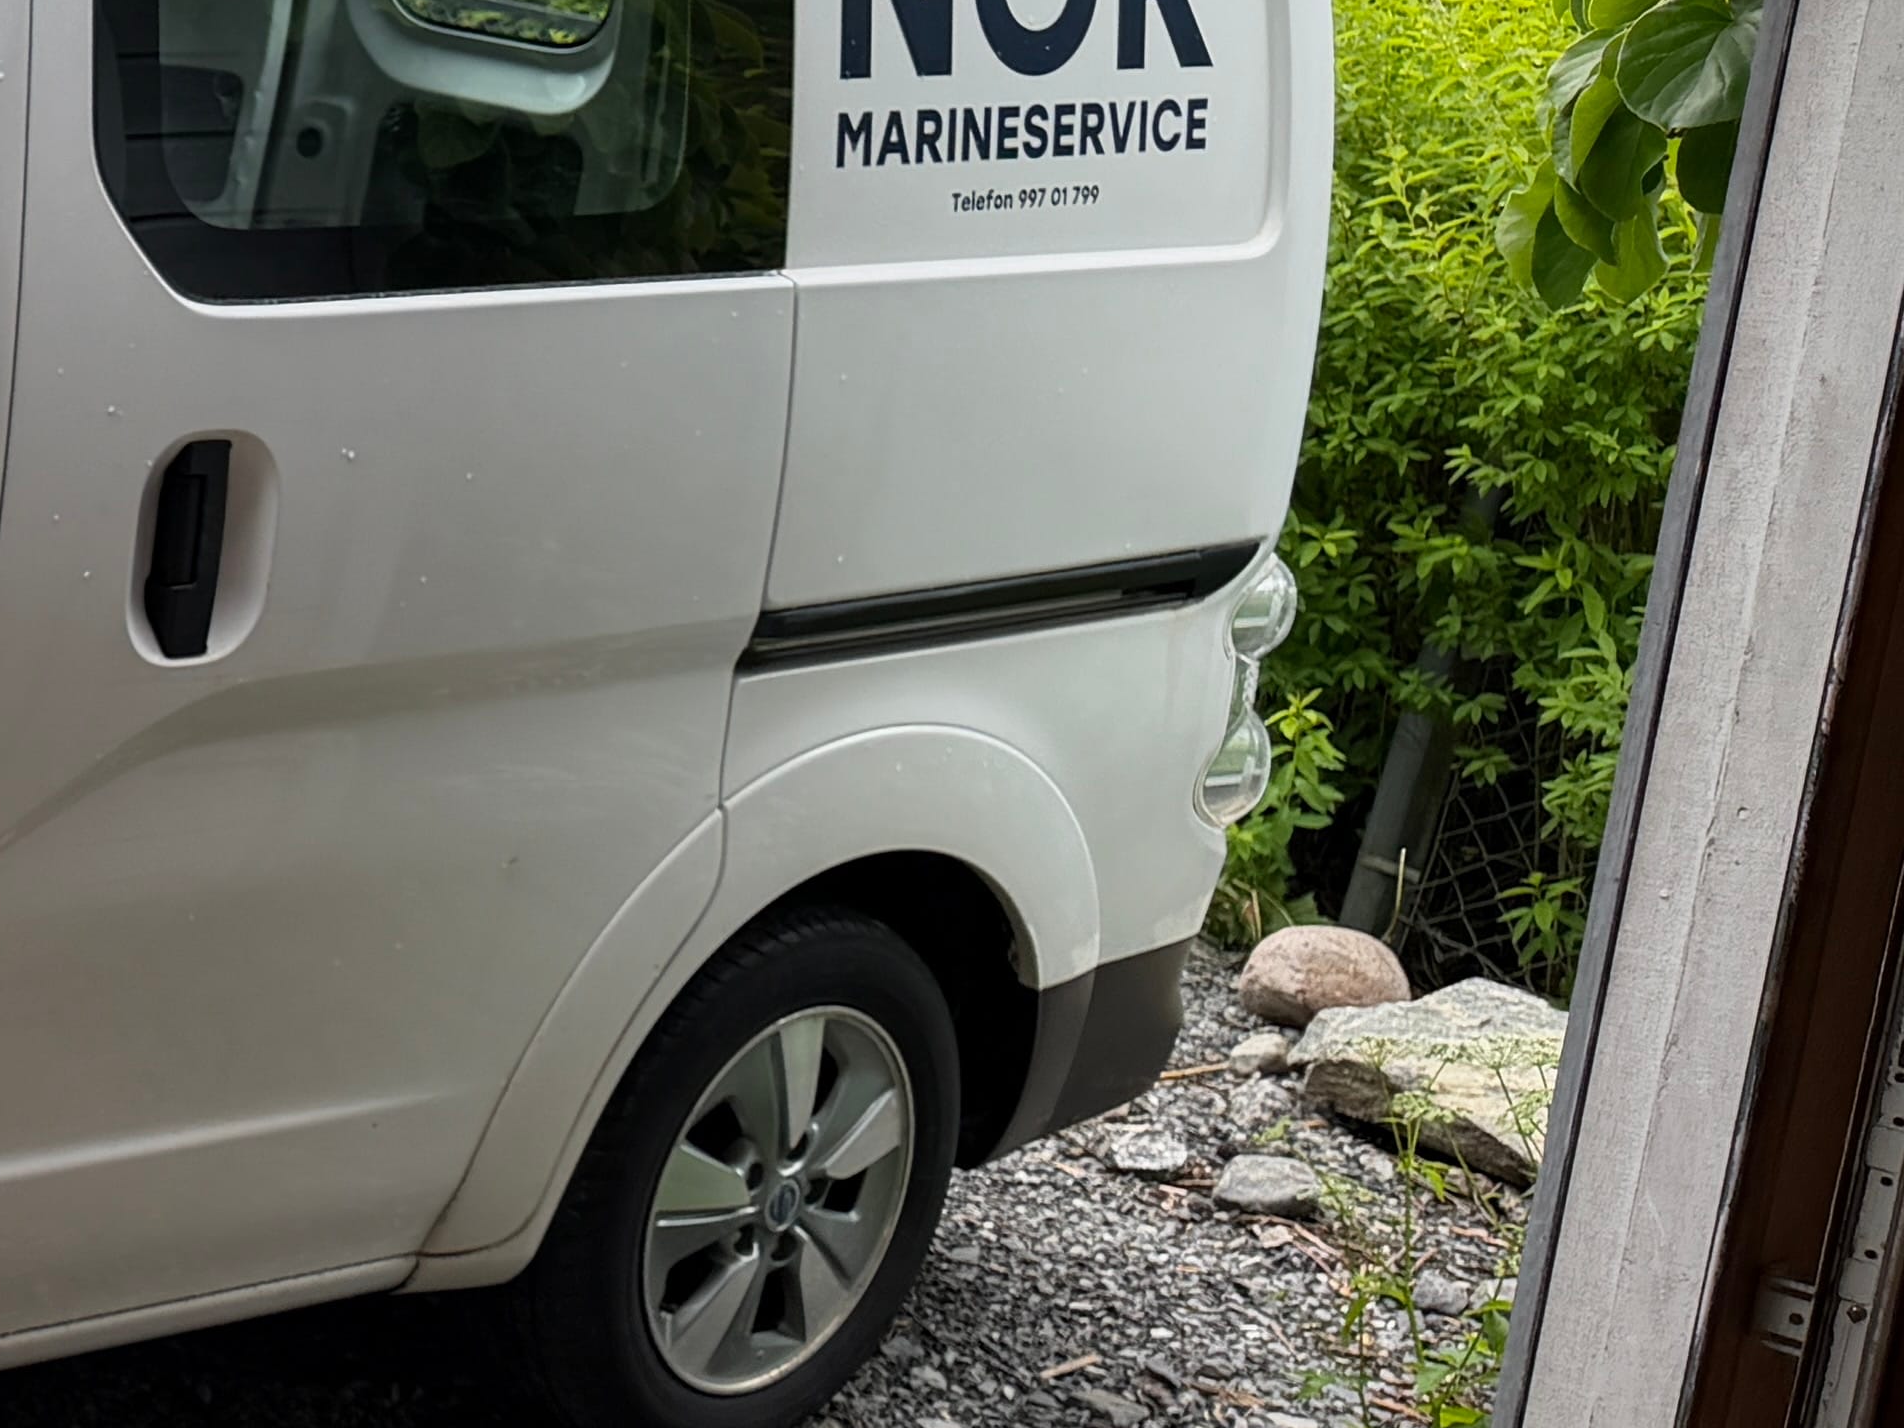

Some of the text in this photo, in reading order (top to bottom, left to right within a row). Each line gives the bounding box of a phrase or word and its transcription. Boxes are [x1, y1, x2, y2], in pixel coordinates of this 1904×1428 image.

[835, 98, 1209, 168] MARINESERVICE
[951, 184, 1100, 212] Telefon 997 01 799
